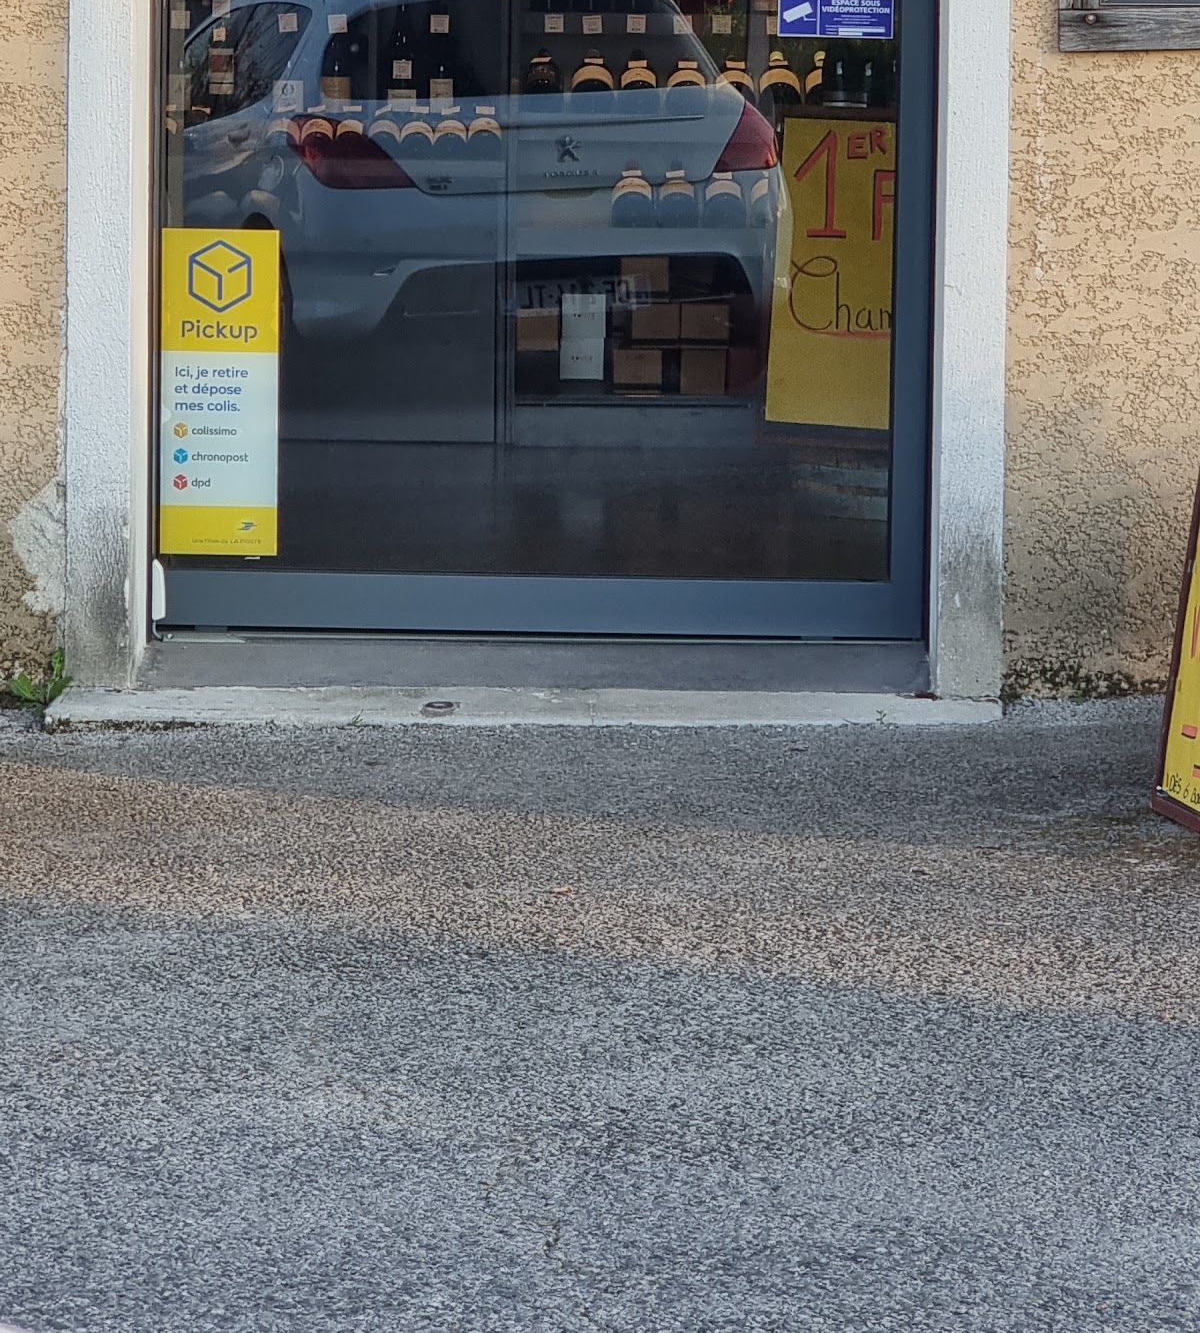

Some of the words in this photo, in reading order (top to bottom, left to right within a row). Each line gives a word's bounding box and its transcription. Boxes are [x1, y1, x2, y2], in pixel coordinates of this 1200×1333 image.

[822, 5, 890, 14] VIDÉOPROTECTION
[181, 319, 258, 343] Pickup
[175, 366, 194, 379] Ici,
[195, 366, 209, 380] je
[212, 367, 249, 378] retire
[174, 384, 188, 394] et
[191, 383, 242, 397] dépose
[174, 401, 204, 411] mes
[207, 400, 241, 412] colis.
[191, 426, 237, 436] colissimo
[191, 452, 249, 464] chronopost
[191, 477, 211, 489] dpd
